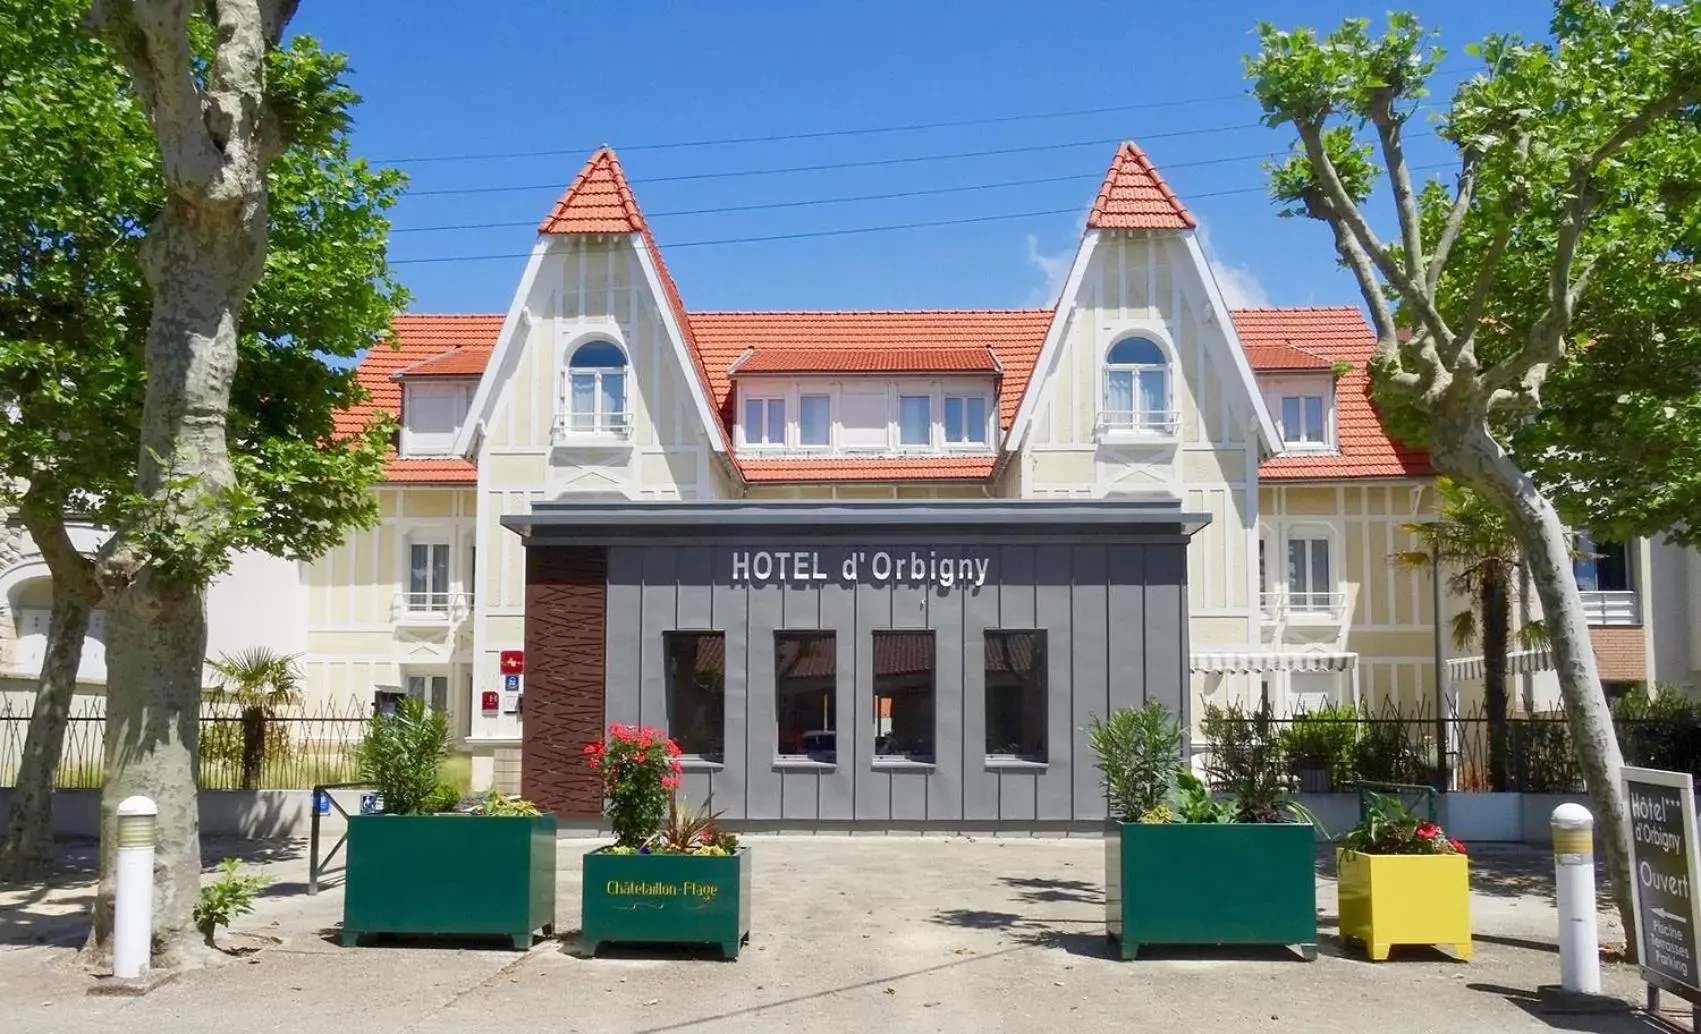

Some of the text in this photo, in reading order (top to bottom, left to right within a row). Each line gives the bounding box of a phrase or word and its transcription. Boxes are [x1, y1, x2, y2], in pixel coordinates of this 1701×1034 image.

[732, 551, 989, 587] HOTEL d'Orbigny
[1631, 791, 1667, 823] Hôtel
[1635, 822, 1681, 855] d'Orbigny
[1640, 860, 1689, 898] Ouvert
[1653, 919, 1684, 941] Piscine
[1655, 950, 1688, 977] Parking
